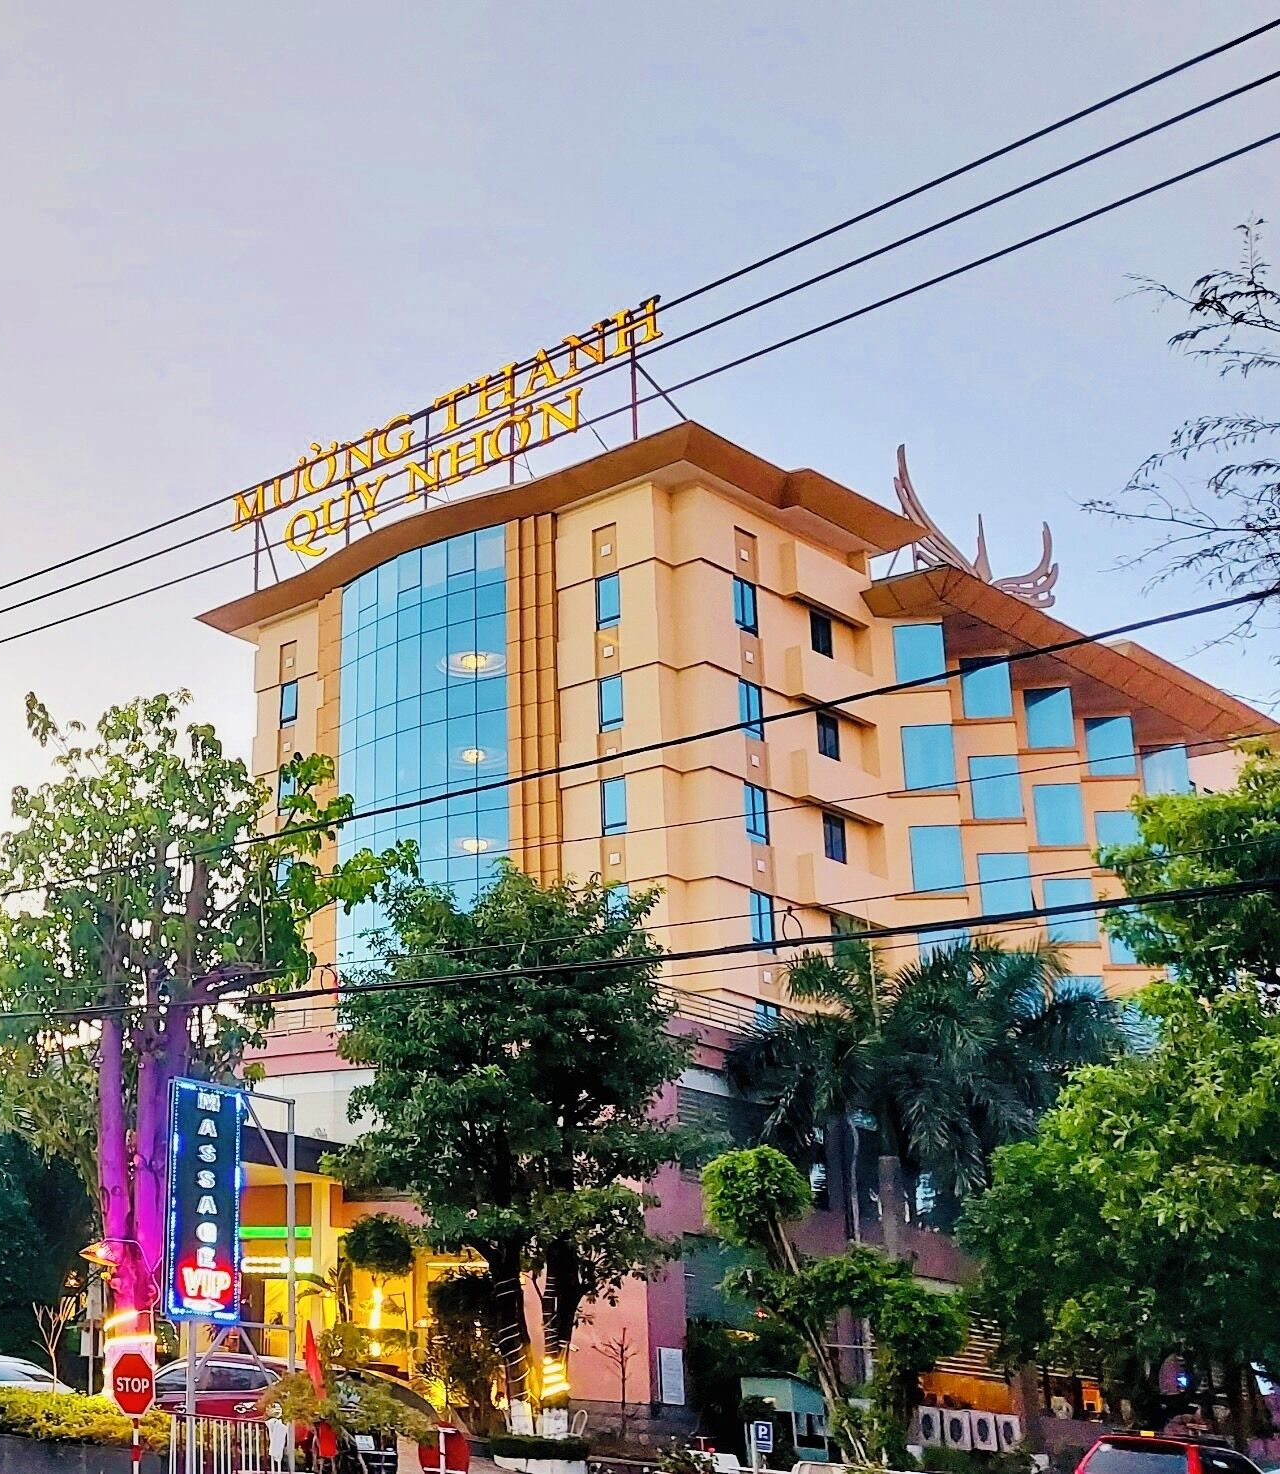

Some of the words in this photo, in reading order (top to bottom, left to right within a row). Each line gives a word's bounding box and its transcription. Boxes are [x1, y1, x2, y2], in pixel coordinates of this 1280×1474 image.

[230, 413, 415, 532] MƯỜNG
[433, 296, 663, 435] THANH
[284, 473, 389, 557] QUY
[403, 387, 583, 504] NHƠN
[195, 1091, 221, 1269] MASSAGE
[182, 1267, 231, 1299] VIP
[116, 1376, 150, 1393] STOP
